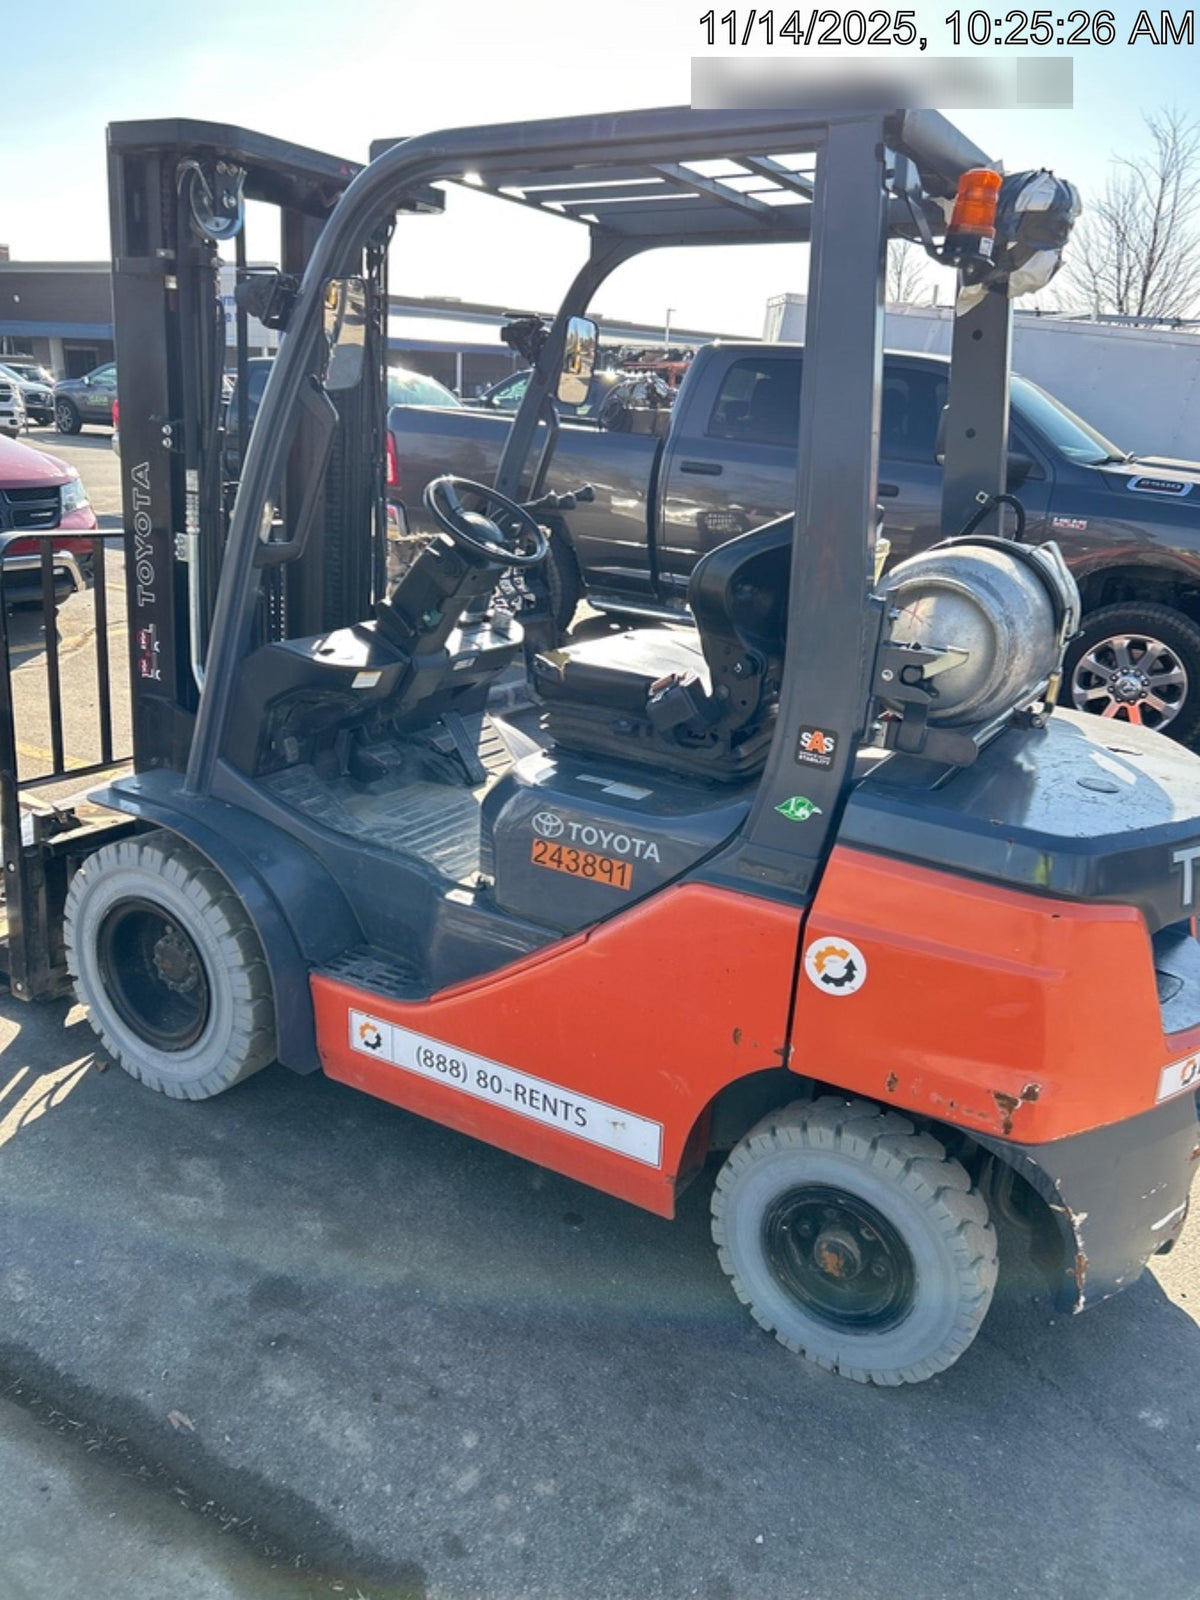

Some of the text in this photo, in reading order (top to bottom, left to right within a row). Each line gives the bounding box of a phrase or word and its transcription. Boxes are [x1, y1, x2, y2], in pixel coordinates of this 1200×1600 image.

[131, 461, 155, 607] TOYOTA
[800, 731, 835, 755] SAS
[533, 840, 628, 887] 243891
[568, 822, 660, 863] TOYOTA
[416, 1046, 588, 1127] (888) 80-RENTS
